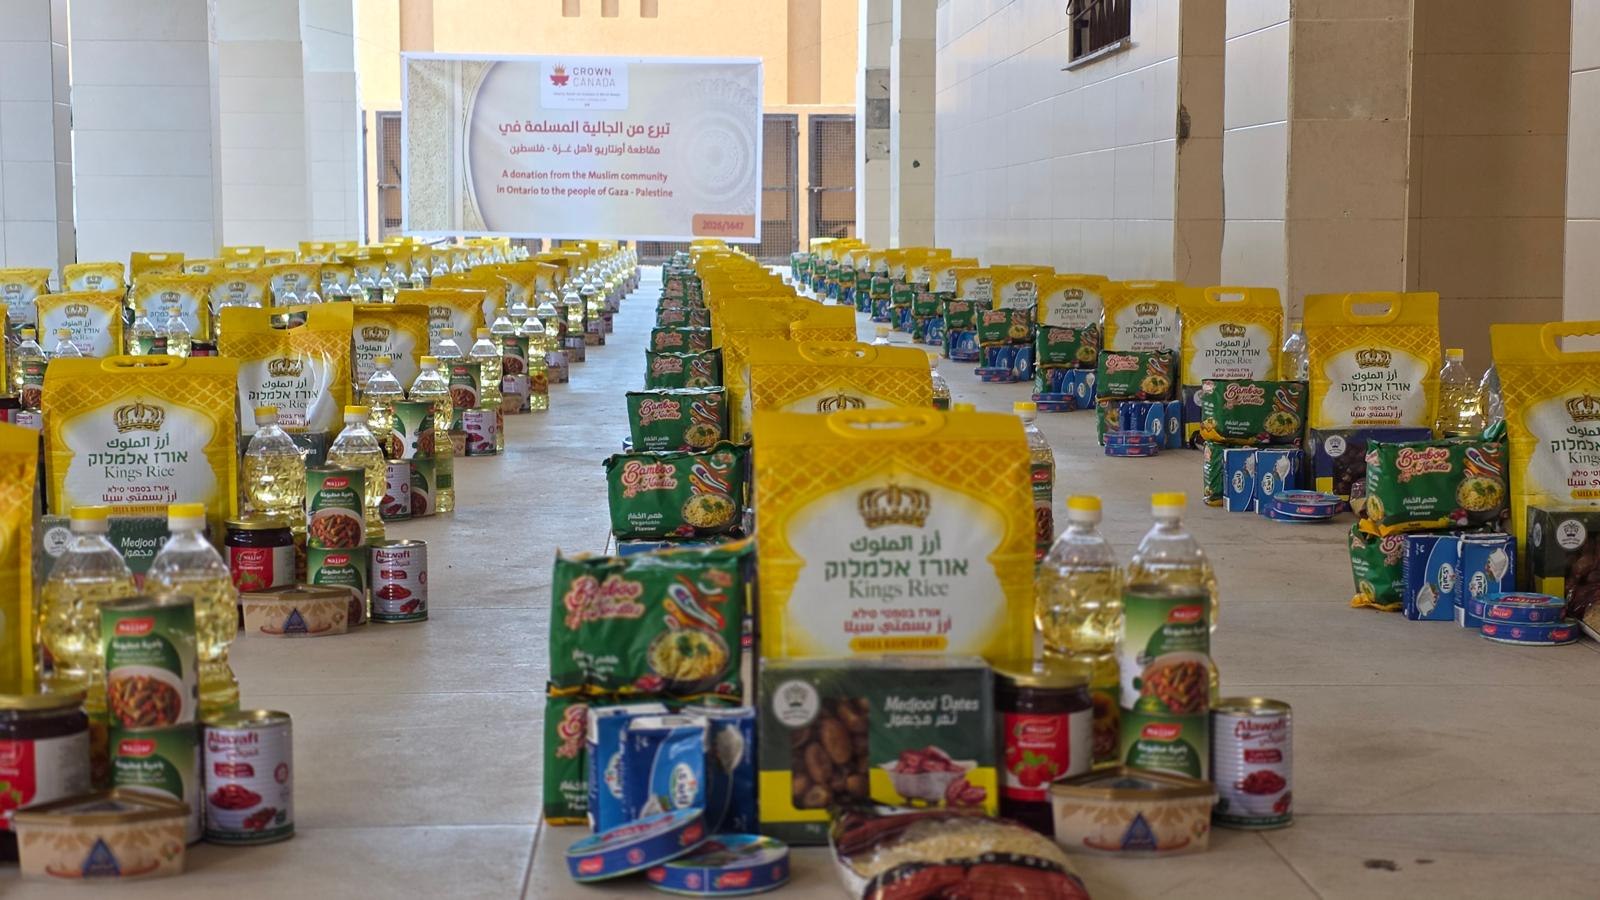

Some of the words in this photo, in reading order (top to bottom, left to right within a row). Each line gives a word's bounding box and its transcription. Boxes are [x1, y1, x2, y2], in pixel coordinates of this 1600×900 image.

[573, 67, 611, 76] CROWN
[573, 77, 616, 87] CANADA
[499, 122, 521, 137] في
[525, 120, 578, 134] المسلمة
[583, 121, 623, 137] الجالية
[627, 124, 644, 138] من
[648, 122, 670, 138] تبرع
[510, 143, 545, 155] فلسطين
[629, 144, 660, 155] مقاطعة
[502, 170, 509, 178] A
[510, 170, 548, 179] donation
[550, 170, 570, 179] from
[572, 171, 586, 180] the
[588, 171, 619, 180] Muslim
[621, 172, 668, 184] community
[496, 184, 505, 193] in
[507, 186, 539, 195] Ontario
[541, 186, 550, 195] to
[552, 186, 566, 196] the
[568, 187, 596, 198] people
[598, 187, 607, 196] of
[608, 187, 629, 197] Gaza
[636, 188, 673, 198] Palestine
[1352, 371, 1384, 382] الملوك
[1386, 369, 1398, 381] أرز
[262, 380, 293, 390] الملوك
[296, 378, 307, 389] أرز
[1342, 382, 1383, 392] אלמלוק
[1387, 383, 1411, 391] אורז
[249, 390, 291, 400] אלמלוק
[296, 390, 319, 399] אורז
[1353, 393, 1379, 403] Kings
[1382, 392, 1401, 401] Rice
[640, 400, 679, 415] Bamboo
[106, 437, 150, 451] الملوك
[154, 433, 170, 450] أرز
[88, 452, 148, 467] אלמלוק
[154, 451, 188, 464] אורז
[1398, 448, 1447, 468] Bamboo
[1569, 452, 1600, 466] King
[105, 466, 142, 482] Kings
[146, 466, 175, 478] Rice
[623, 462, 673, 484] Bamboo
[108, 485, 125, 493] סילא
[121, 537, 157, 549] Medjool
[850, 535, 913, 557] الملوك
[920, 530, 941, 556] أرز
[824, 558, 911, 582] אלמלוק
[920, 559, 968, 577] אורז
[849, 580, 903, 603] Kings
[908, 579, 950, 597] Rice
[884, 696, 938, 713] Medjool
[942, 694, 979, 712] Dates
